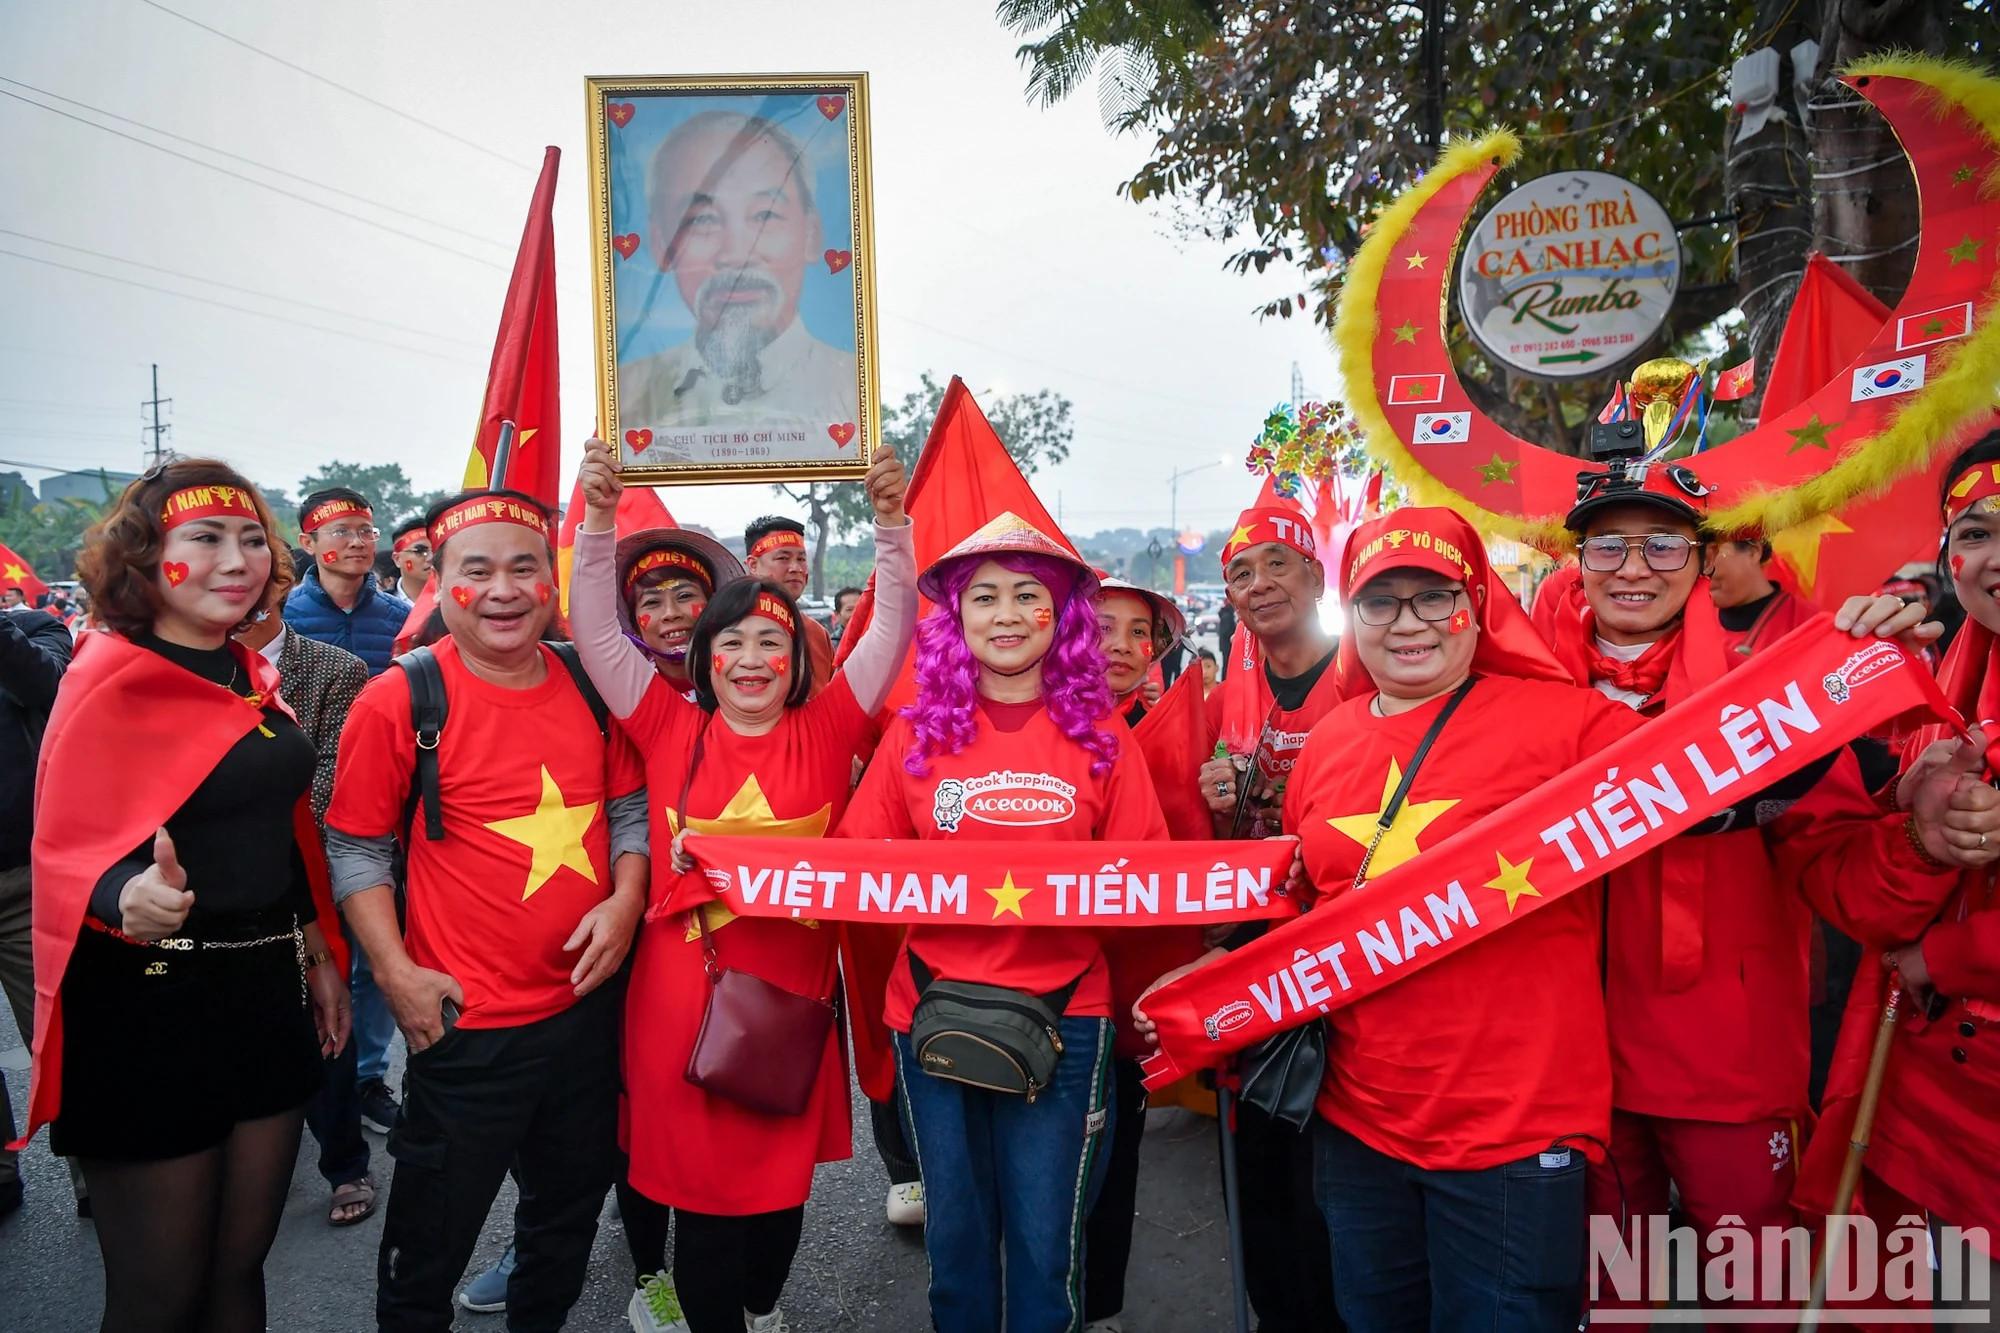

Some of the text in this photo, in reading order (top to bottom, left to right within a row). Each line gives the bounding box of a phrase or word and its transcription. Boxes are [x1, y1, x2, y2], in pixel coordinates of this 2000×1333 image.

[1496, 189, 1638, 240] PHÒNG TRÀ
[1477, 232, 1661, 279] CA NHẠC
[1501, 279, 1641, 335] Rumba
[777, 432, 806, 442] MINH
[176, 488, 213, 513] NAM
[331, 501, 349, 514] NAM
[445, 503, 540, 530] VIỆT NAM VÔ ĐỊCH
[778, 534, 796, 544] NAM
[1359, 536, 1384, 567] NAM
[1412, 531, 1431, 549] VÔ
[1434, 537, 1463, 565] ĐỊCH
[656, 552, 688, 564] VIỆT
[760, 598, 788, 622] VÔ ĐỊCH
[1839, 658, 1858, 676] Cook
[966, 773, 1075, 796] Cook happiness
[1248, 680, 1821, 1023] VIỆT NAM TIẾN LÊN
[737, 857, 1272, 918] VIỆT NAM TIẾN LÊN
